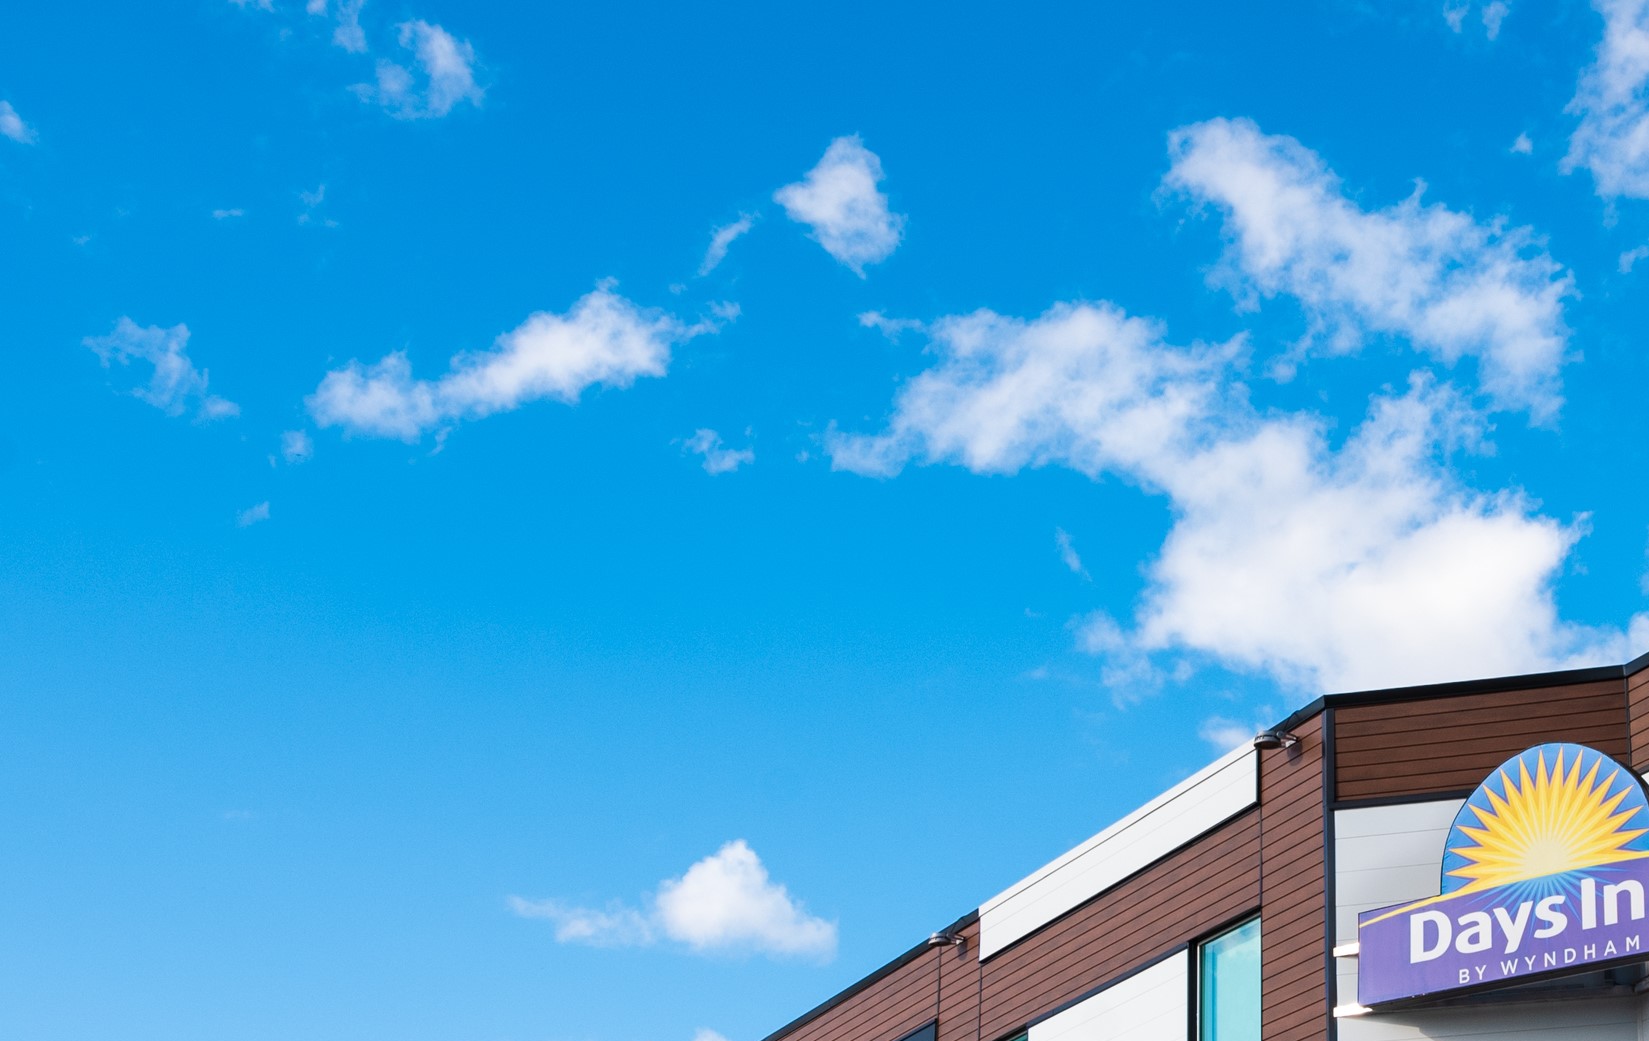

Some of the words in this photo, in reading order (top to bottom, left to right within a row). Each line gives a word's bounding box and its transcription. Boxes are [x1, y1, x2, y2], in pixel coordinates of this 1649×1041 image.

[1410, 895, 1567, 964] Days
[1459, 964, 1487, 985] BY
[1500, 935, 1641, 976] WYNDHAM
